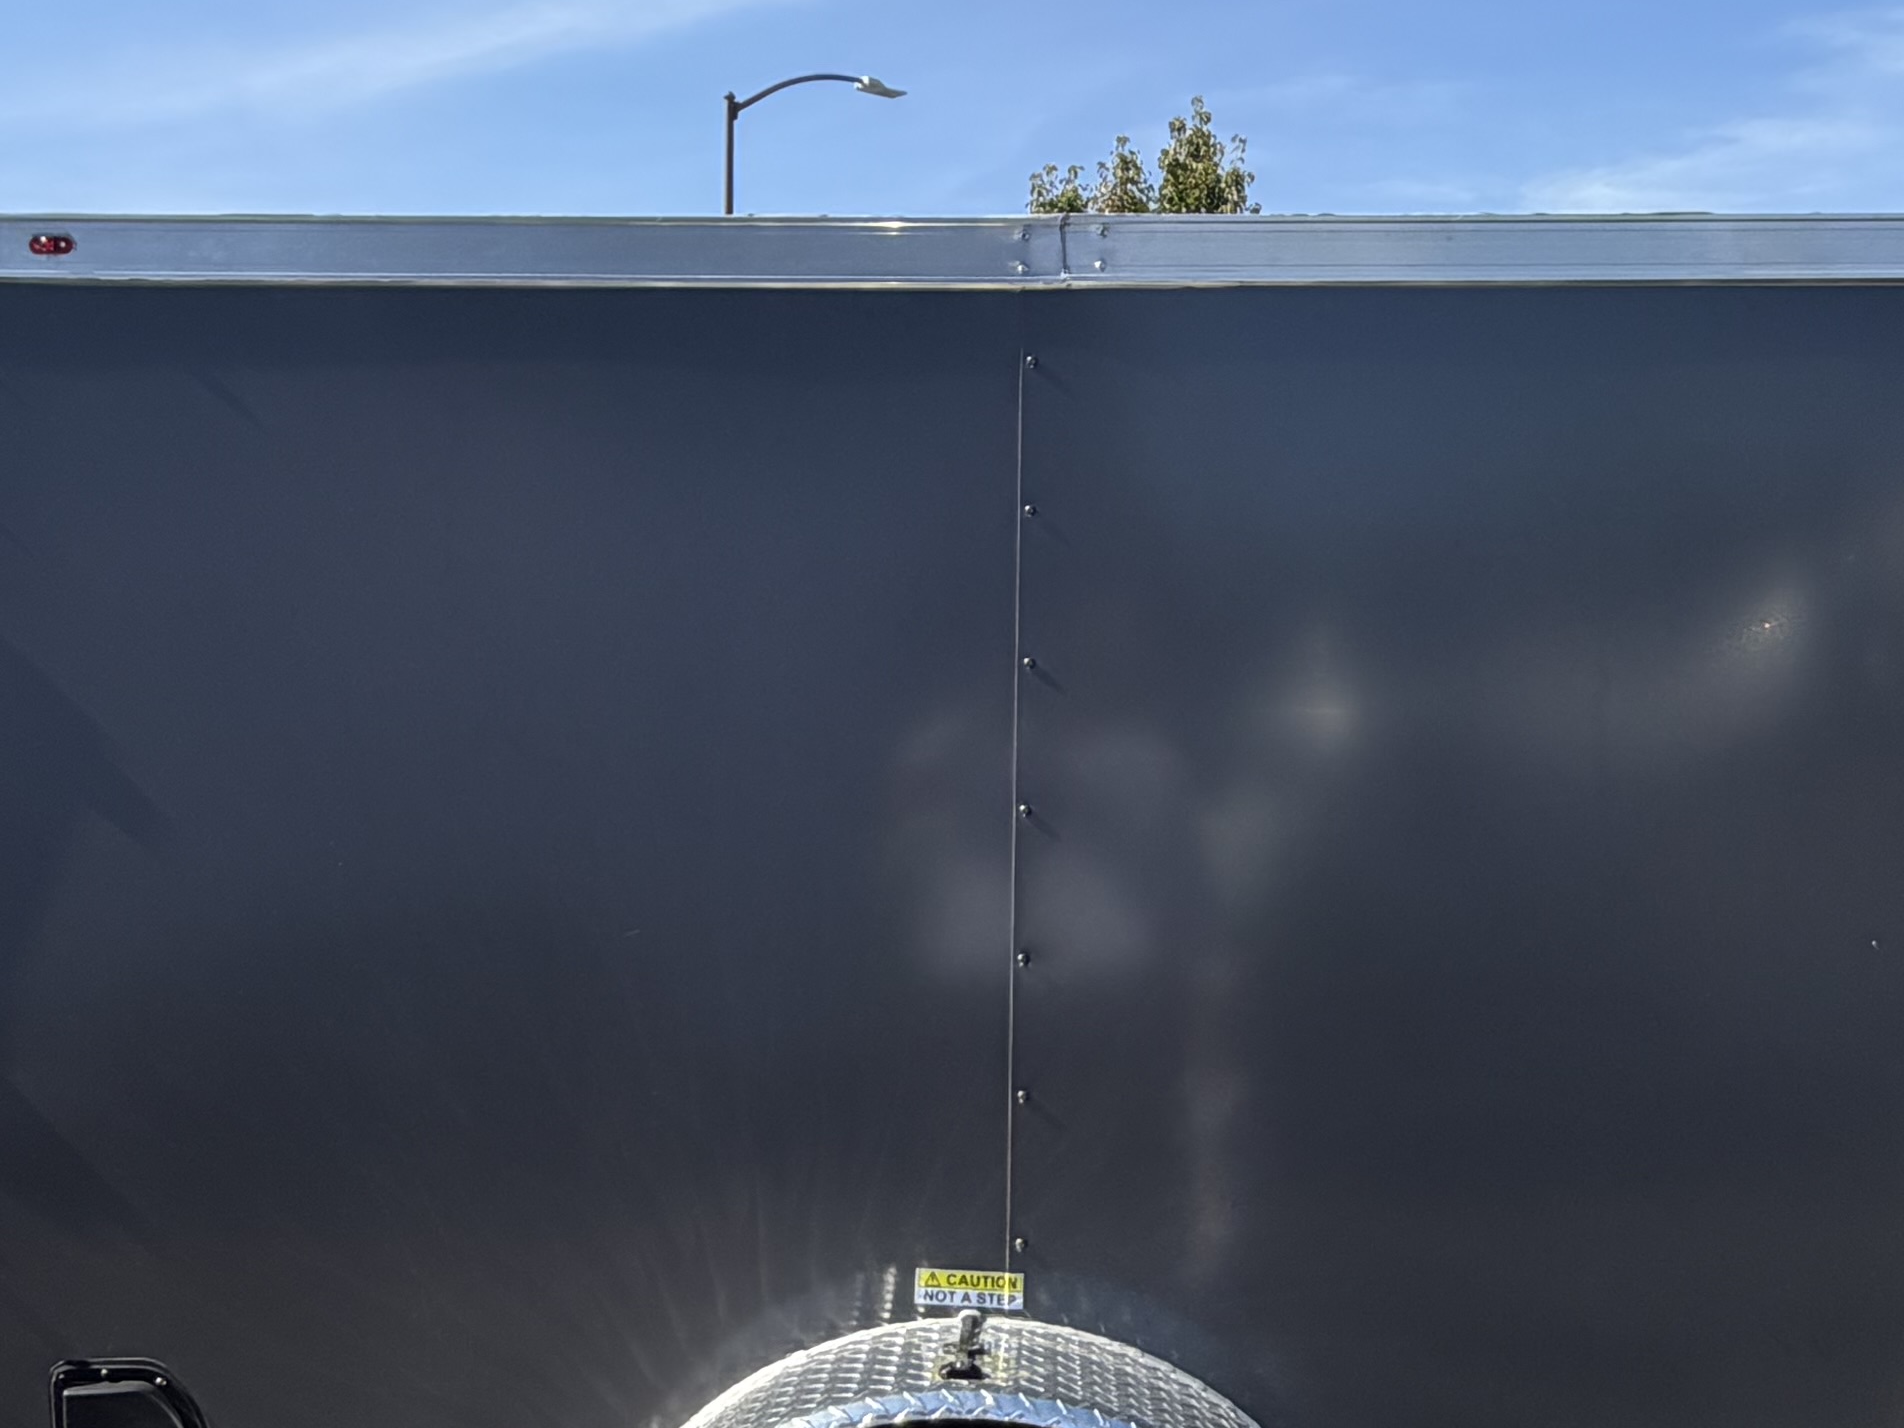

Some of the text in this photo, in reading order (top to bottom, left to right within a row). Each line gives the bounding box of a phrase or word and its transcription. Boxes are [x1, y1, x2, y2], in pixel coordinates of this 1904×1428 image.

[946, 1273, 1018, 1289] CAUTION
[923, 1289, 1018, 1306] NOT A STEP
